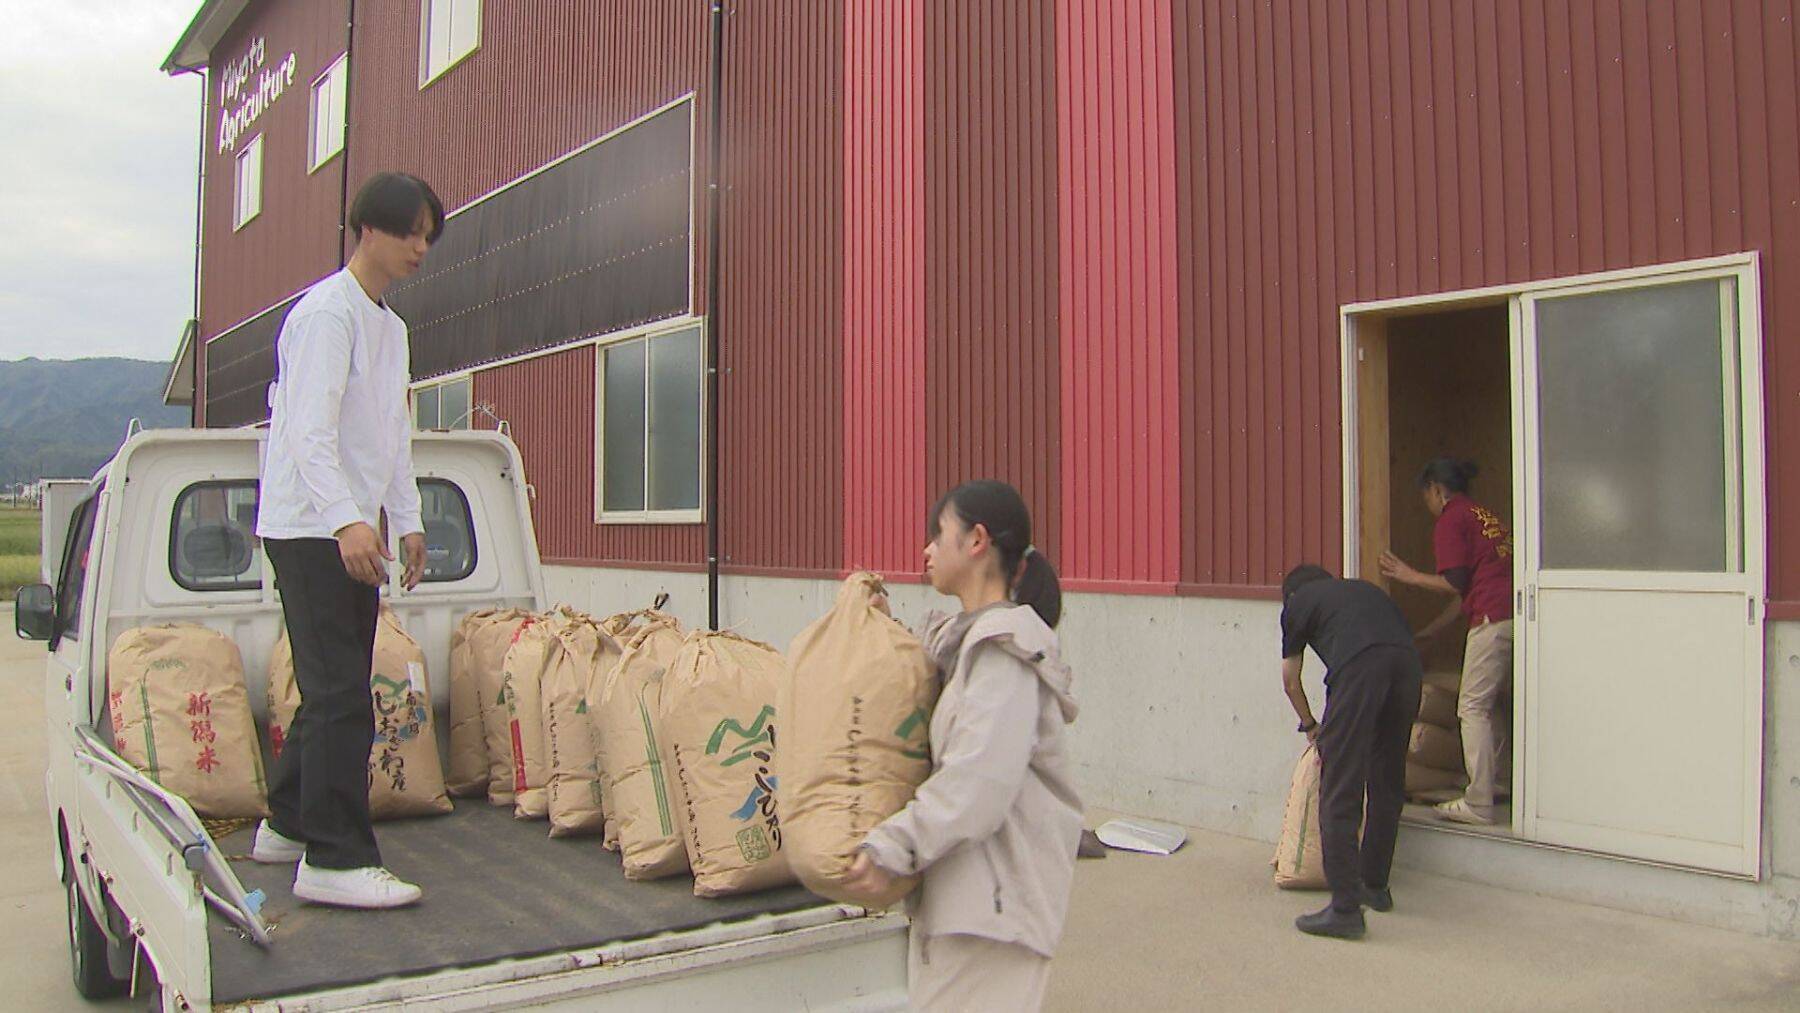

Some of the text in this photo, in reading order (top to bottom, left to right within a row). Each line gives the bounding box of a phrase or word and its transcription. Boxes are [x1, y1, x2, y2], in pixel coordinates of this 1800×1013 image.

[218, 52, 296, 154] Agriculture
[219, 37, 265, 108] Miyata
[186, 691, 221, 774] 新潟米
